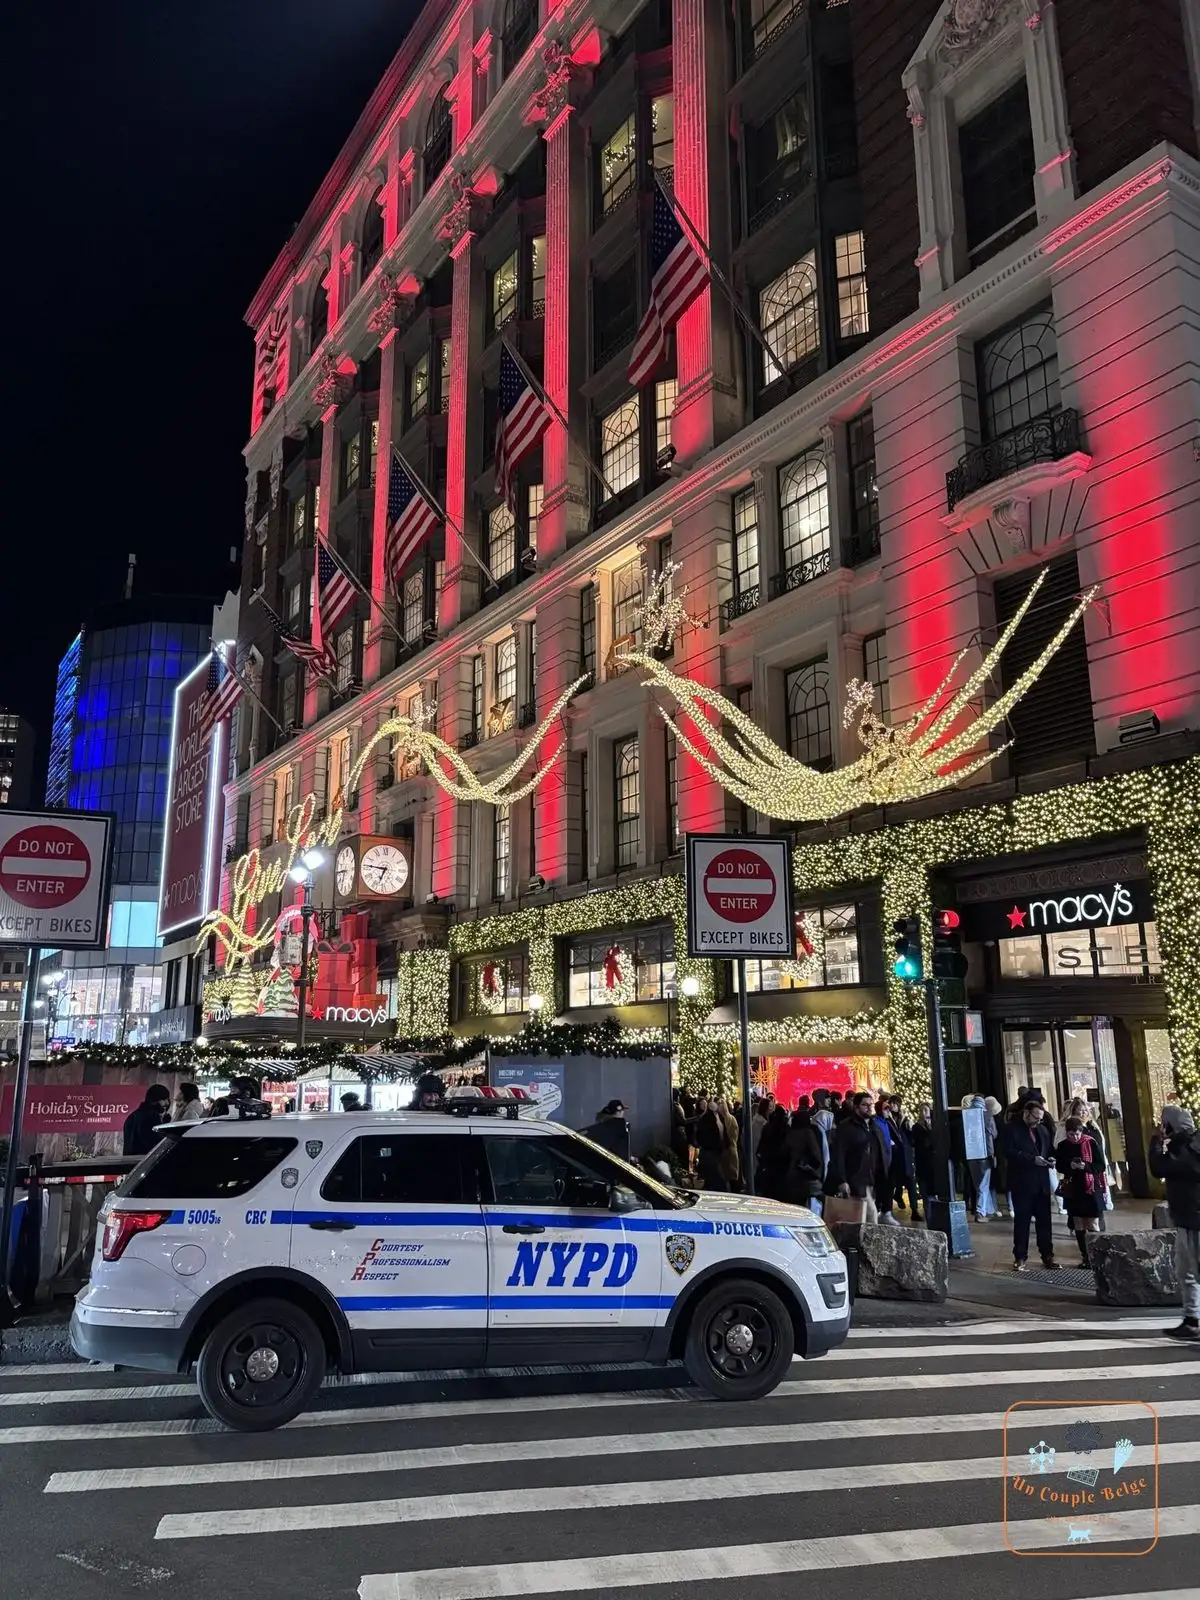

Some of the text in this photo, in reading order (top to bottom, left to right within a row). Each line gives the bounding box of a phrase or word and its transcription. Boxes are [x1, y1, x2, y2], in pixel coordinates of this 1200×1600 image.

[173, 752, 210, 804] LARGEST
[175, 791, 203, 833] STORE
[19, 840, 74, 855] DO NOT
[717, 862, 760, 875] DO NOT
[16, 880, 65, 894] ENTER
[720, 897, 758, 909] ENTER
[1029, 882, 1133, 926] macy's
[0, 916, 92, 933] XCEPT BIKES
[701, 931, 783, 945] EXCEPT BIKES
[1058, 945, 1148, 969] STE
[326, 1005, 387, 1027] macy's
[30, 1101, 129, 1117] Holiday Square
[245, 1210, 267, 1225] CRC
[715, 1222, 762, 1237] POLICE
[506, 1241, 638, 1288] NYPD
